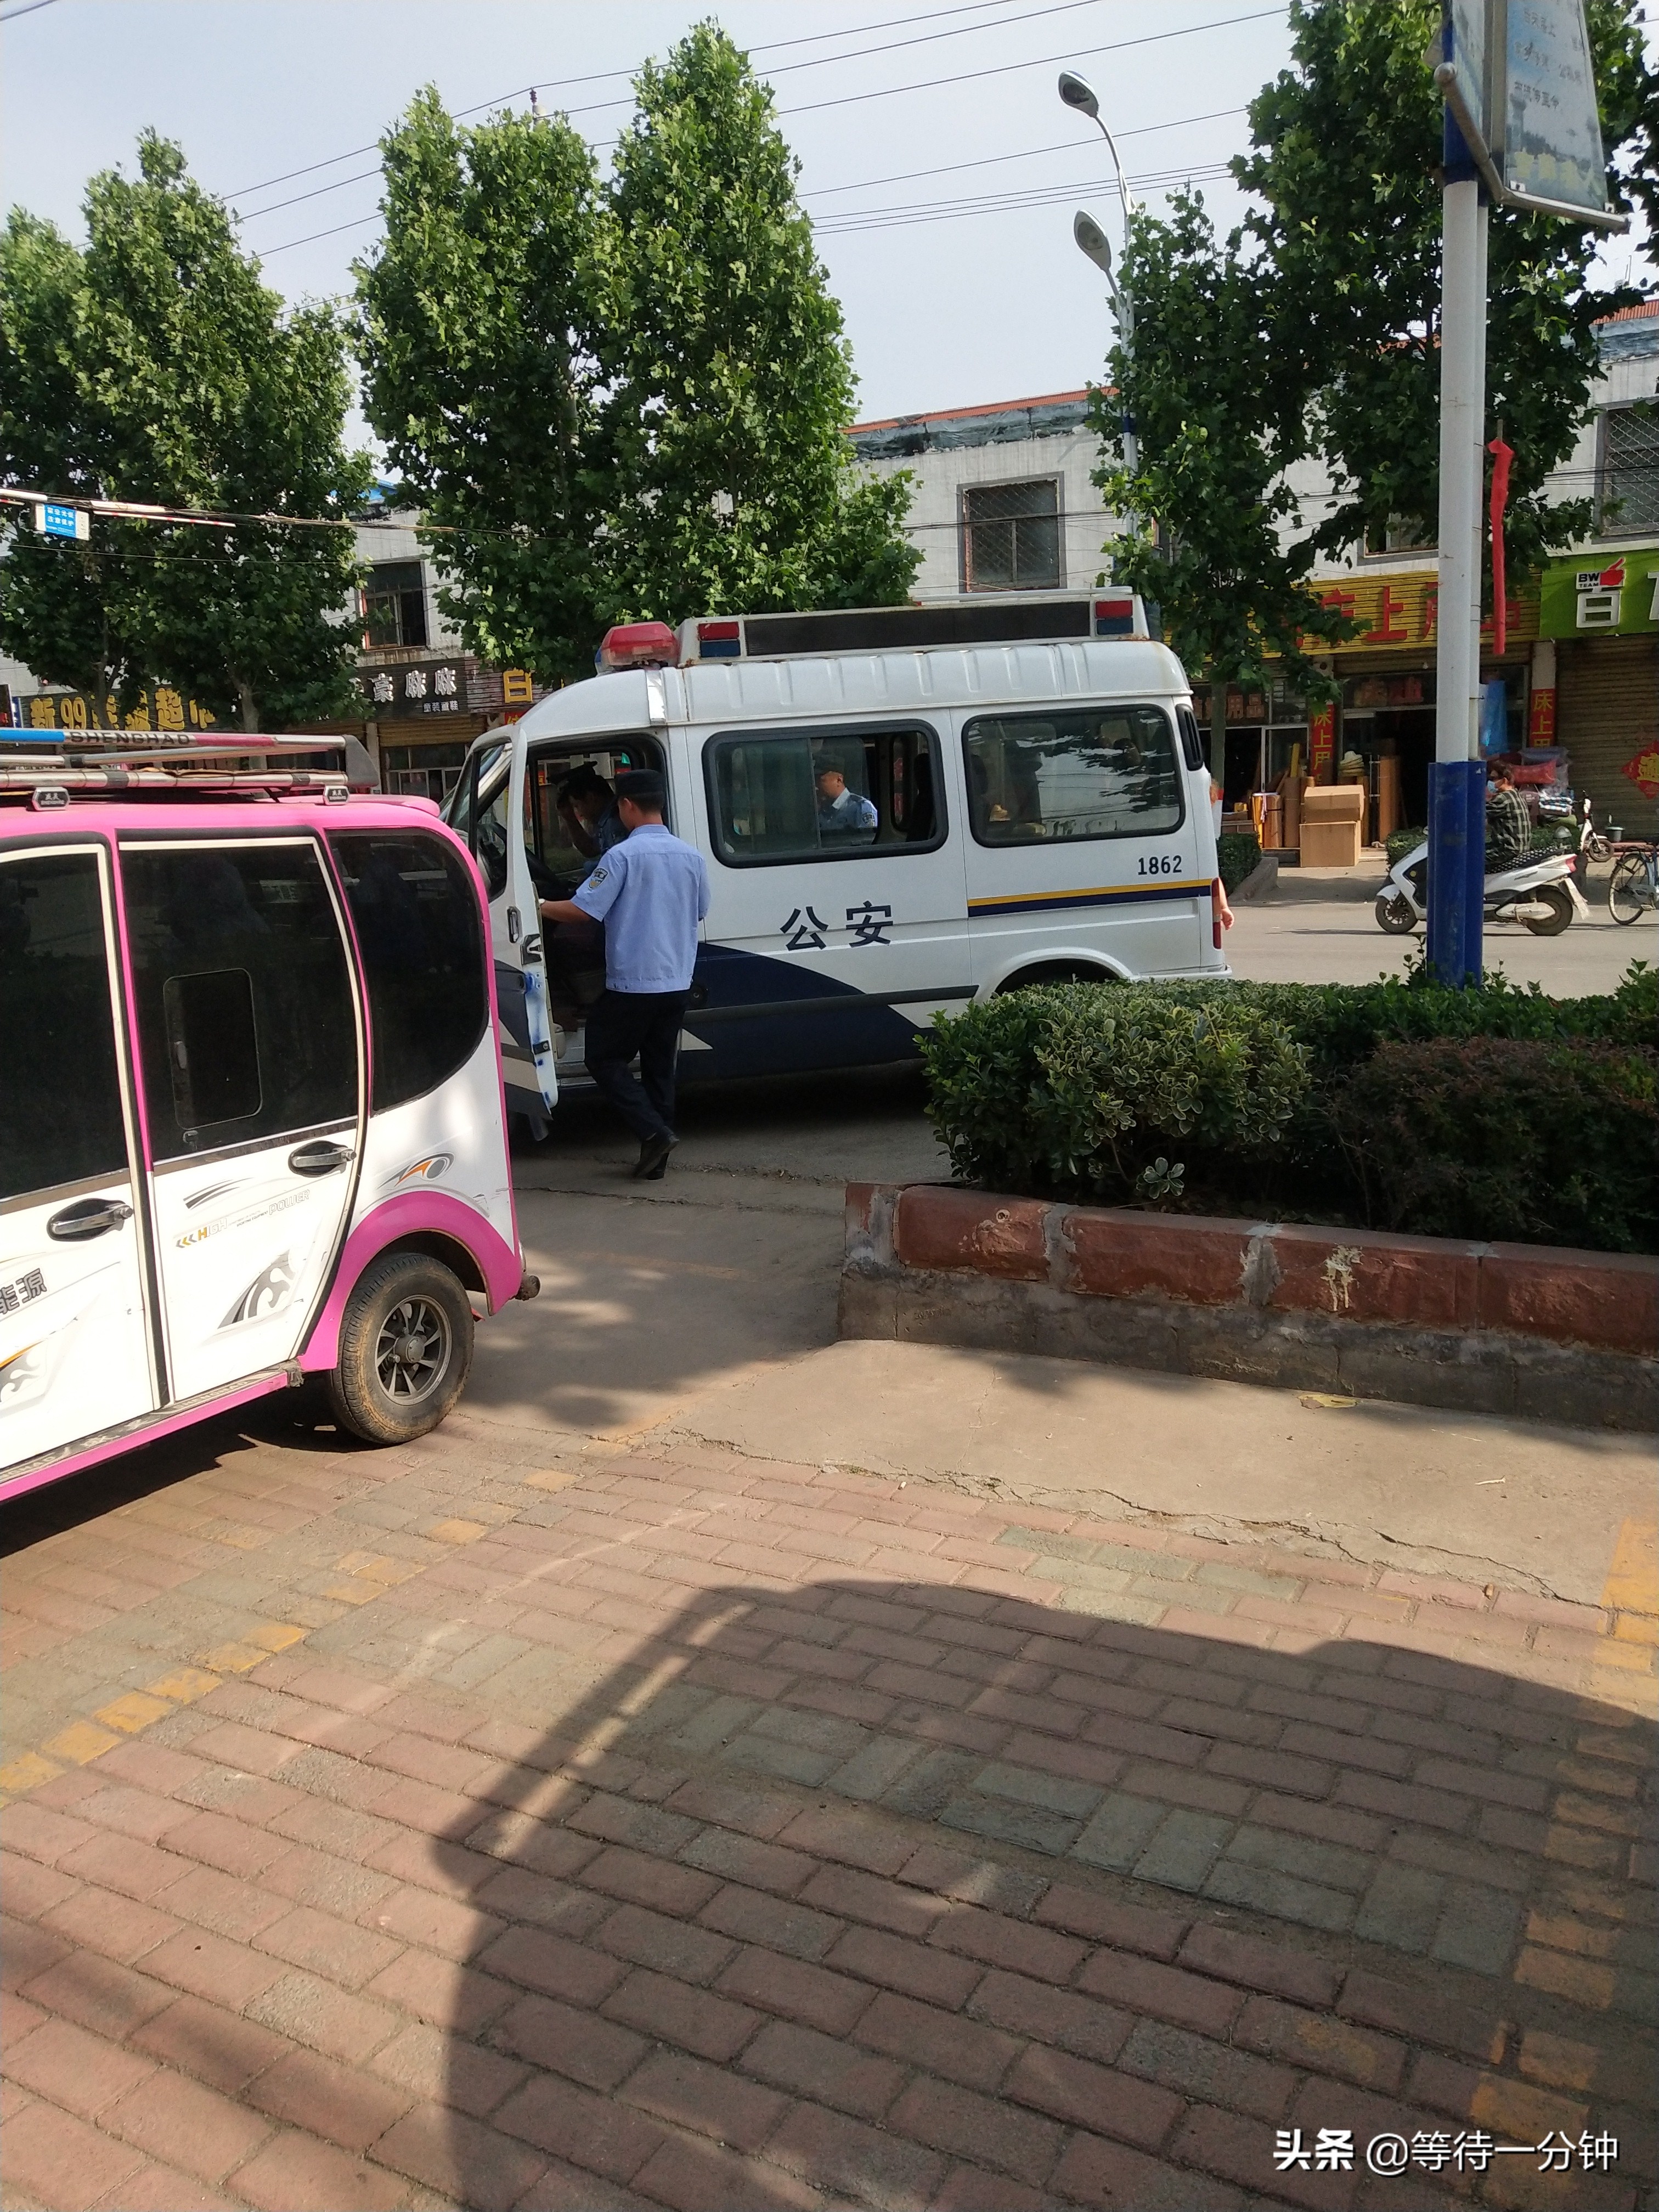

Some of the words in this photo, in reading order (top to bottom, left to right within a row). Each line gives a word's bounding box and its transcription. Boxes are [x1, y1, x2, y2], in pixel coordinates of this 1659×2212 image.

[1578, 573, 1600, 582] BW
[69, 731, 190, 745] SHENGHAO
[1313, 707, 1333, 783] 床上用
[1138, 855, 1182, 875] 1862
[779, 900, 893, 951] 公安
[269, 1189, 311, 1216] POWER
[198, 1216, 228, 1242] HIGH
[0, 1268, 48, 1315] 能源
